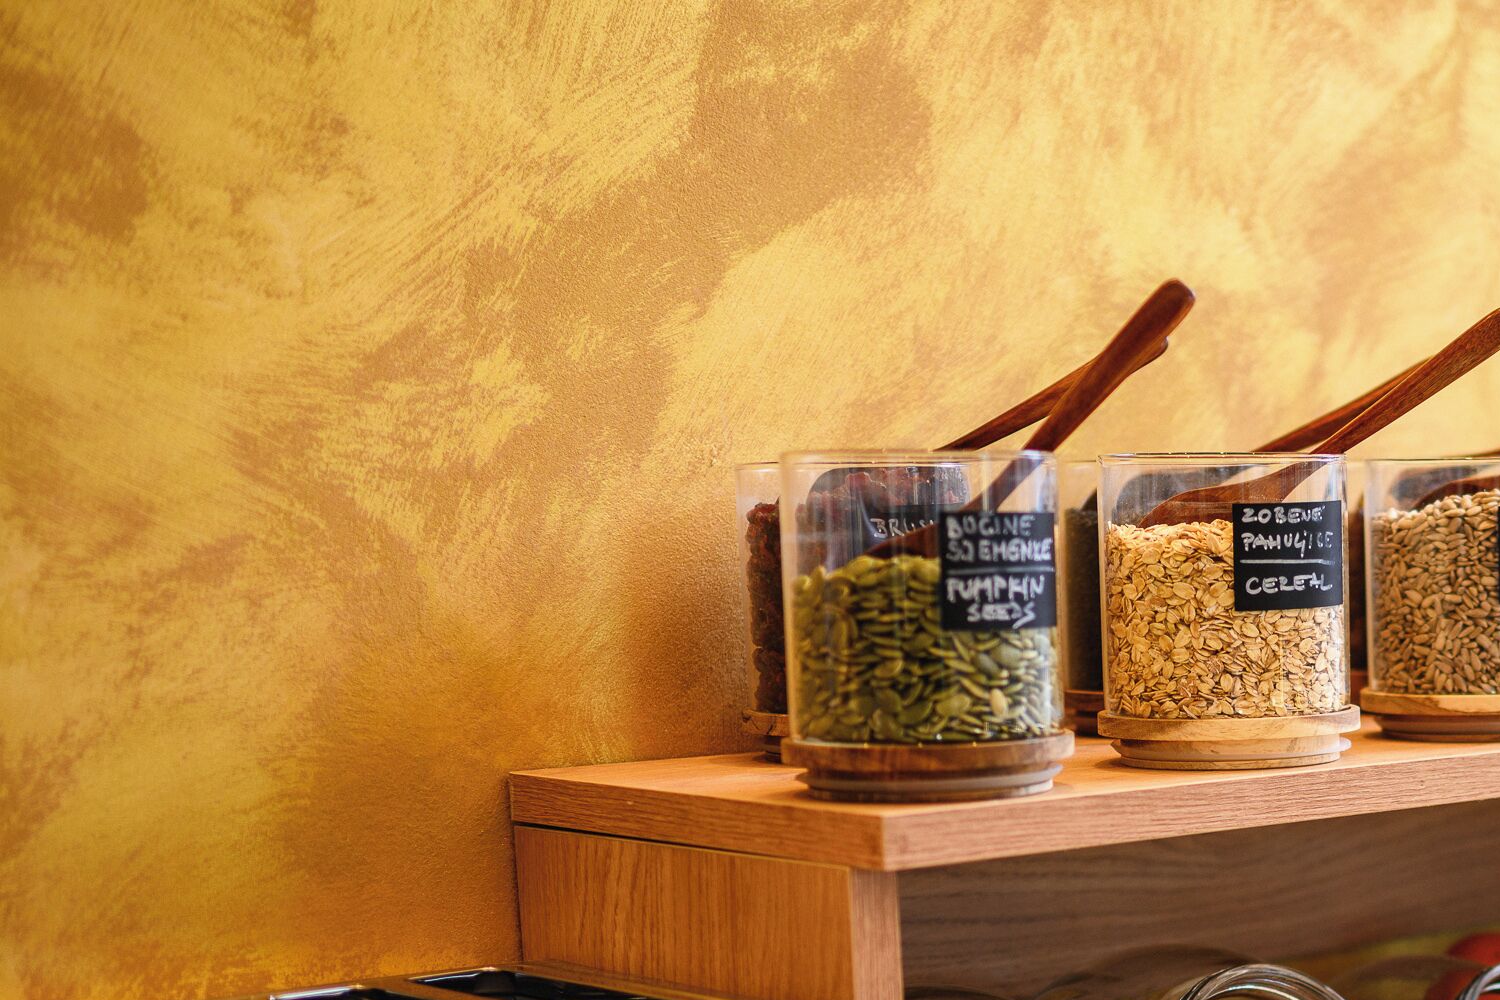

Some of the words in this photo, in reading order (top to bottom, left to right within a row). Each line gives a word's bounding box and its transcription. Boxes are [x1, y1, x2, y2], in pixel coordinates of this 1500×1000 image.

[1240, 505, 1325, 525] ZOBENE
[944, 574, 1046, 603] PUMPKIN
[1245, 572, 1333, 595] CEREAL
[966, 602, 1036, 630] SEEDS
